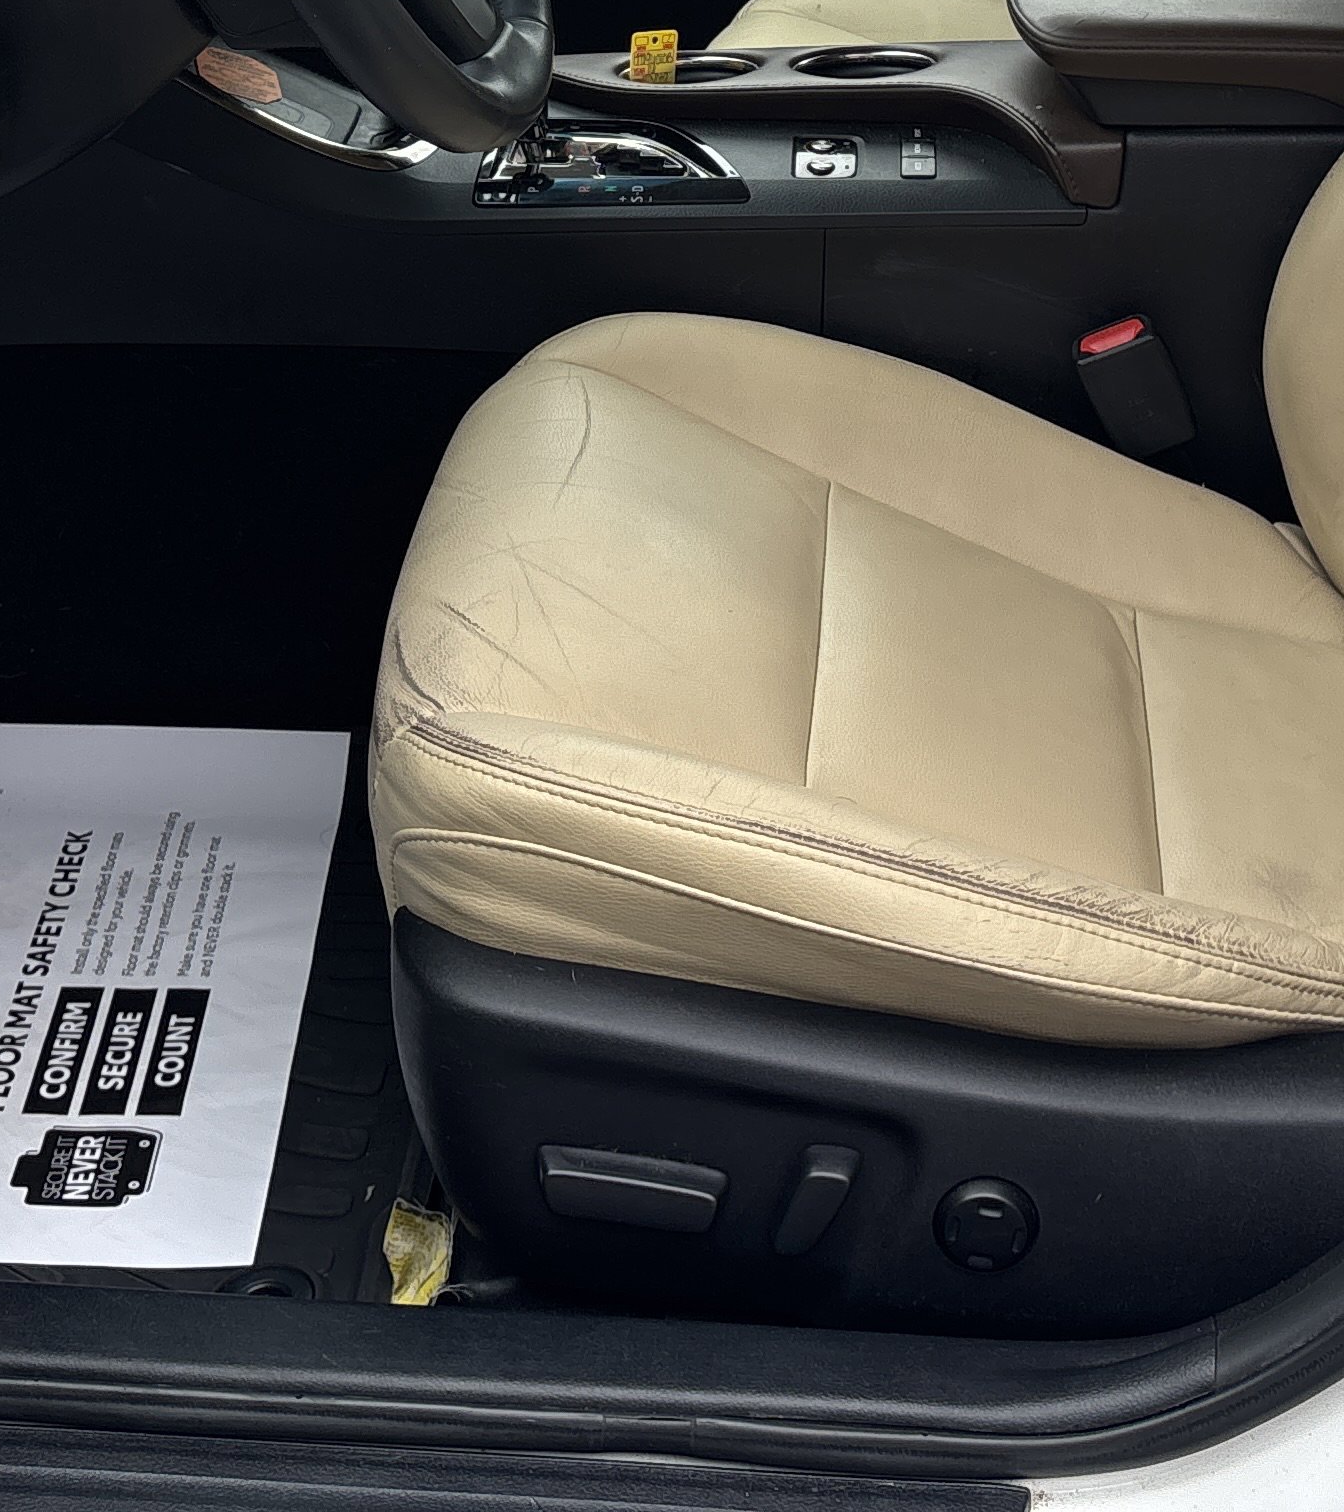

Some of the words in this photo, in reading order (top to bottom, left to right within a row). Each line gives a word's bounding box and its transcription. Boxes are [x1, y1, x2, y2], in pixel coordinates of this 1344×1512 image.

[48, 830, 93, 898] CHECK
[22, 902, 69, 977] SAFETY
[4, 981, 44, 1029] MAT
[40, 1002, 91, 1100] CONFIRM
[97, 1012, 143, 1091] SECURE
[155, 1014, 196, 1087] COUNT
[42, 1148, 74, 1199] SECURE
[57, 1136, 76, 1147] IT
[62, 1136, 105, 1200] NEVER
[106, 1136, 128, 1150] IT
[92, 1151, 125, 1200] STACK
